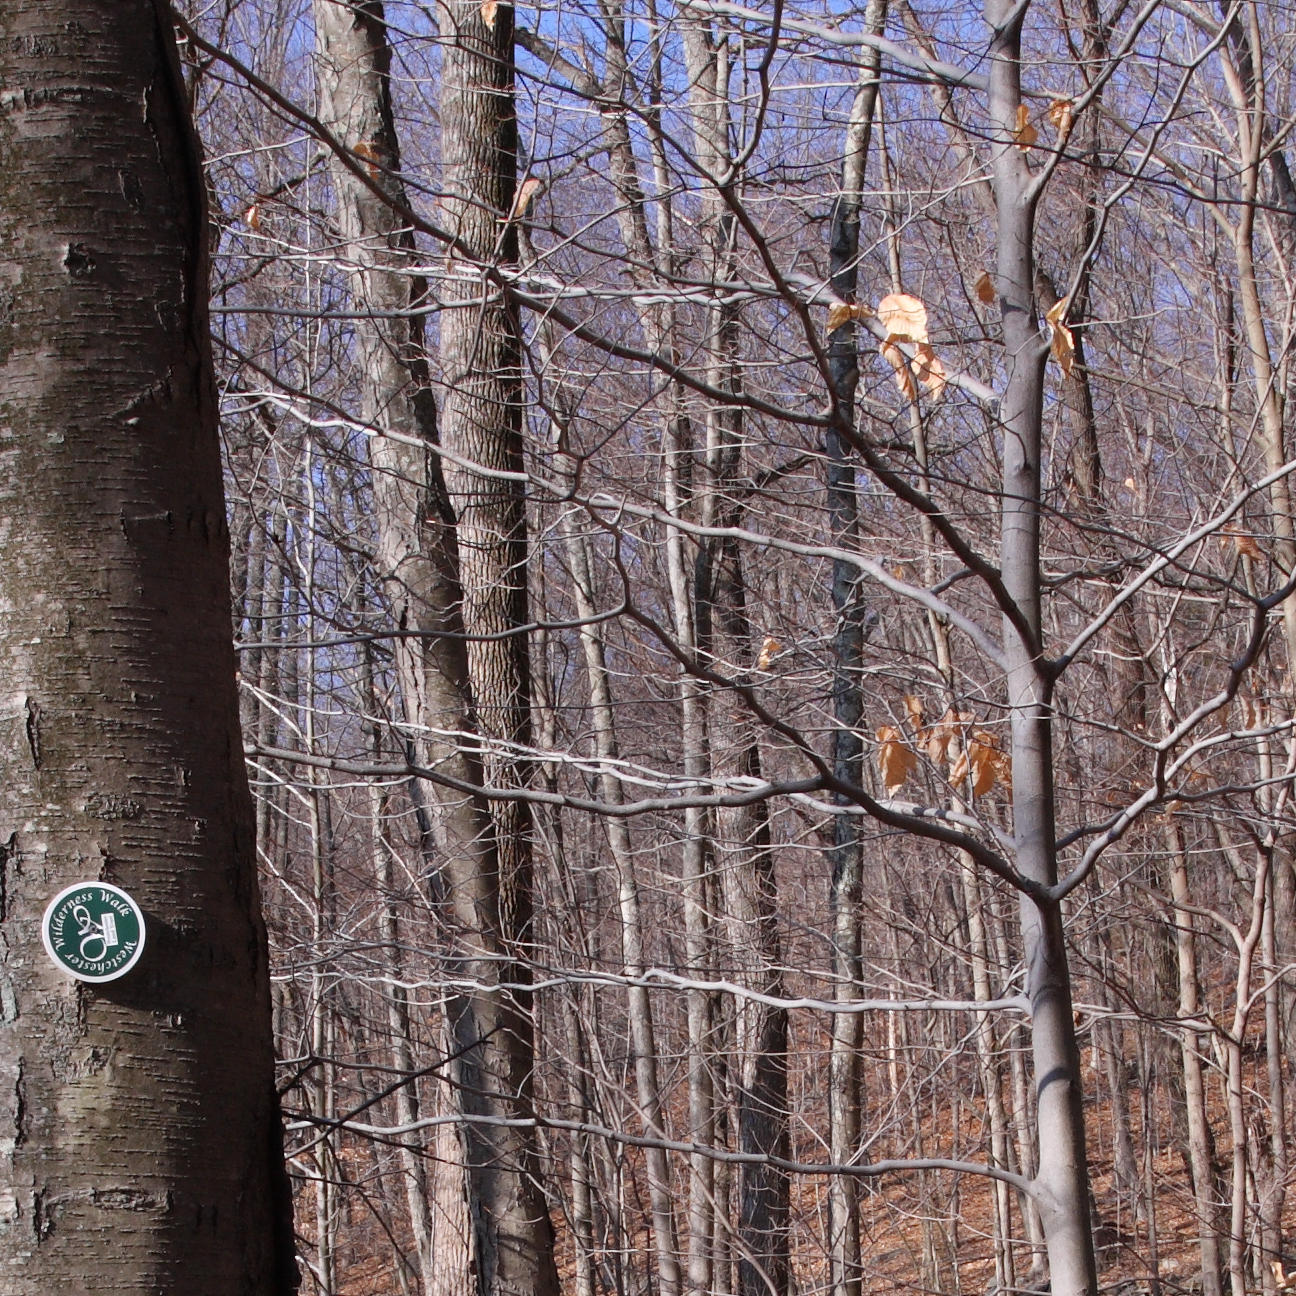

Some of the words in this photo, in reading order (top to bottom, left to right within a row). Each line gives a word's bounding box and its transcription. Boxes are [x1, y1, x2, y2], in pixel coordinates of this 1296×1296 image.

[100, 890, 132, 917] Walk
[51, 892, 93, 951] Wilderness
[64, 941, 137, 974] Westchester
